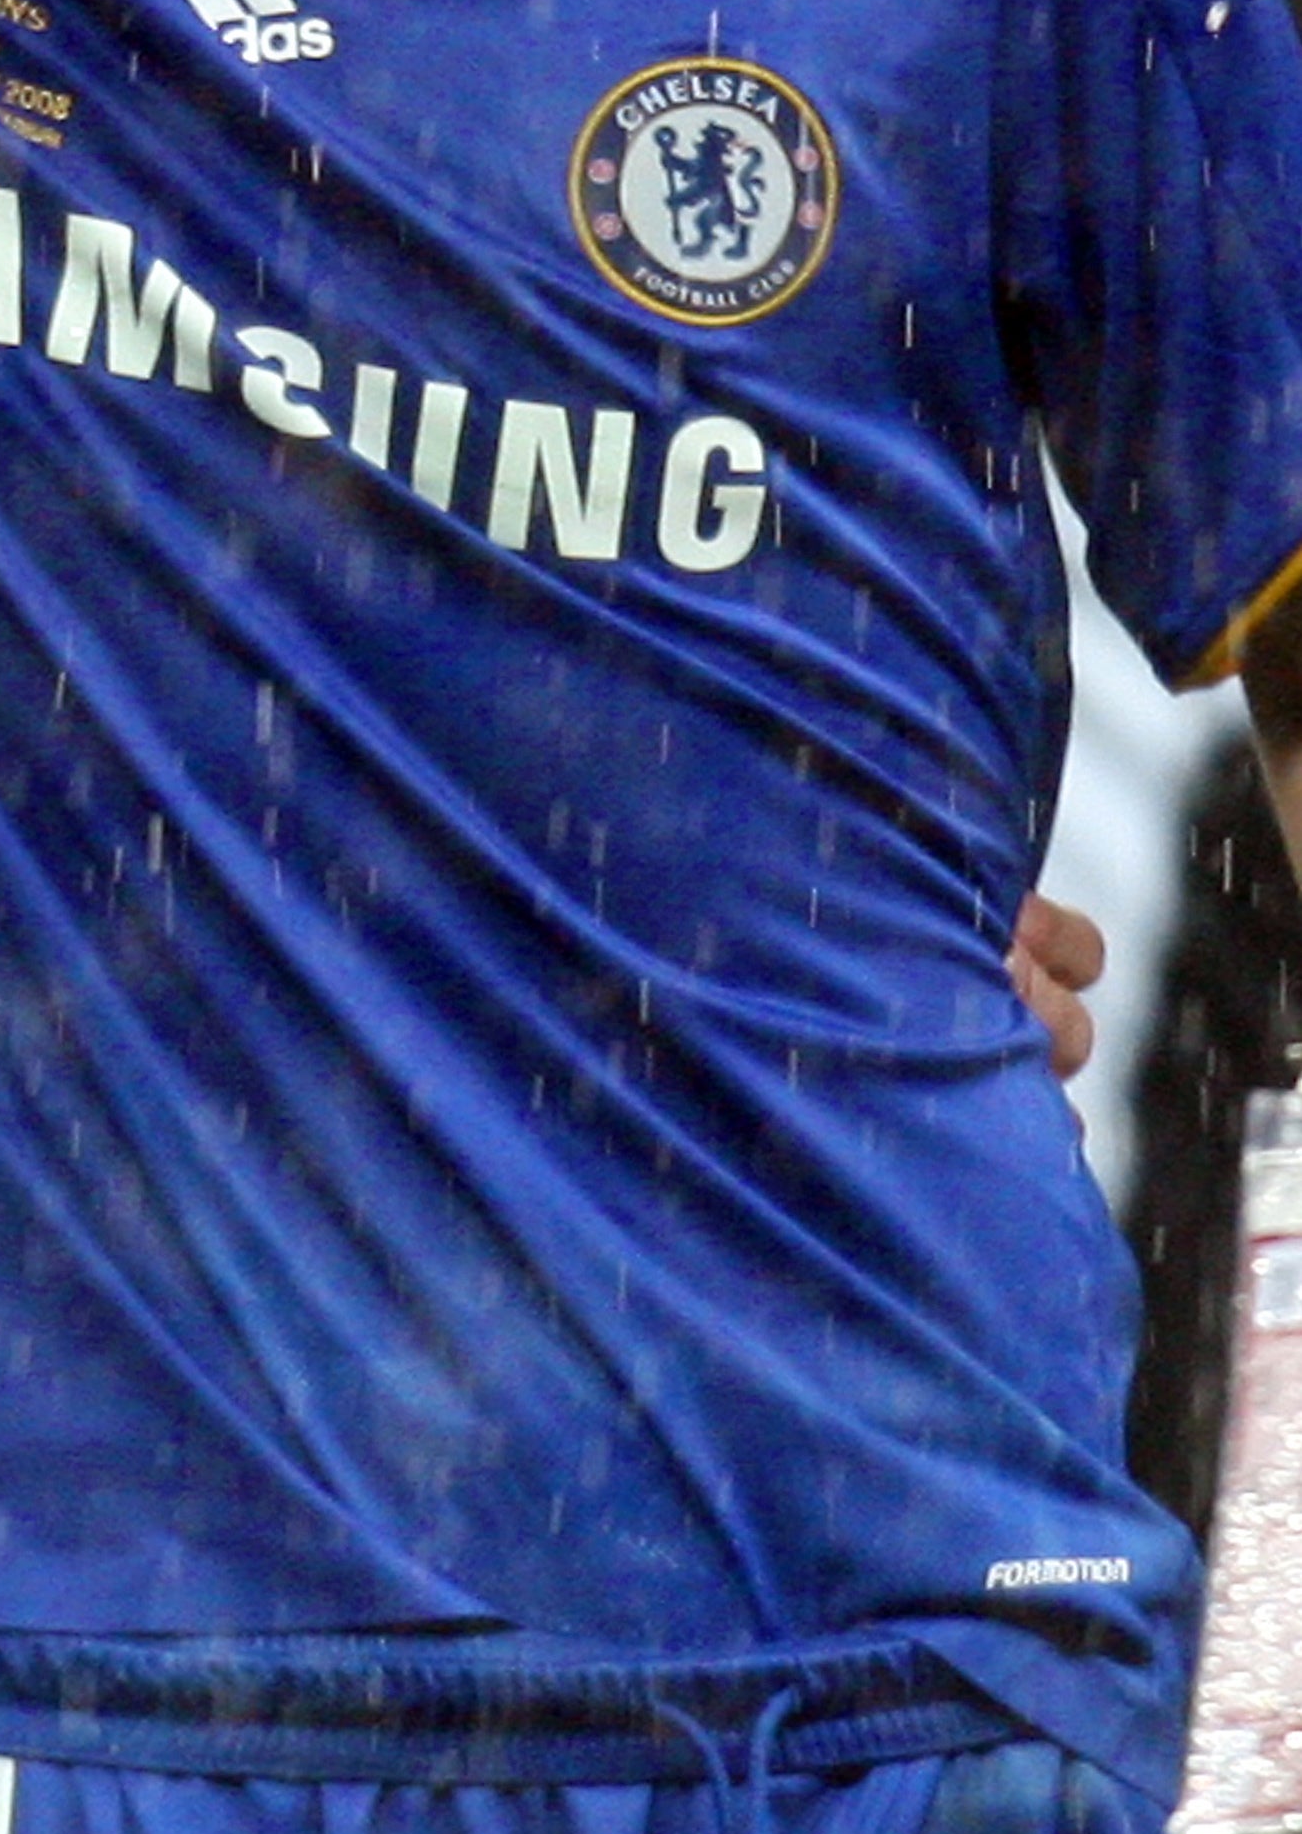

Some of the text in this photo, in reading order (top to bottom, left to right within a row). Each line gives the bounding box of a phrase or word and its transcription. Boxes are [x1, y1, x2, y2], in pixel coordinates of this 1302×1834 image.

[614, 74, 780, 132] CHELSEA
[634, 259, 796, 306] FOOTBALL CLUB
